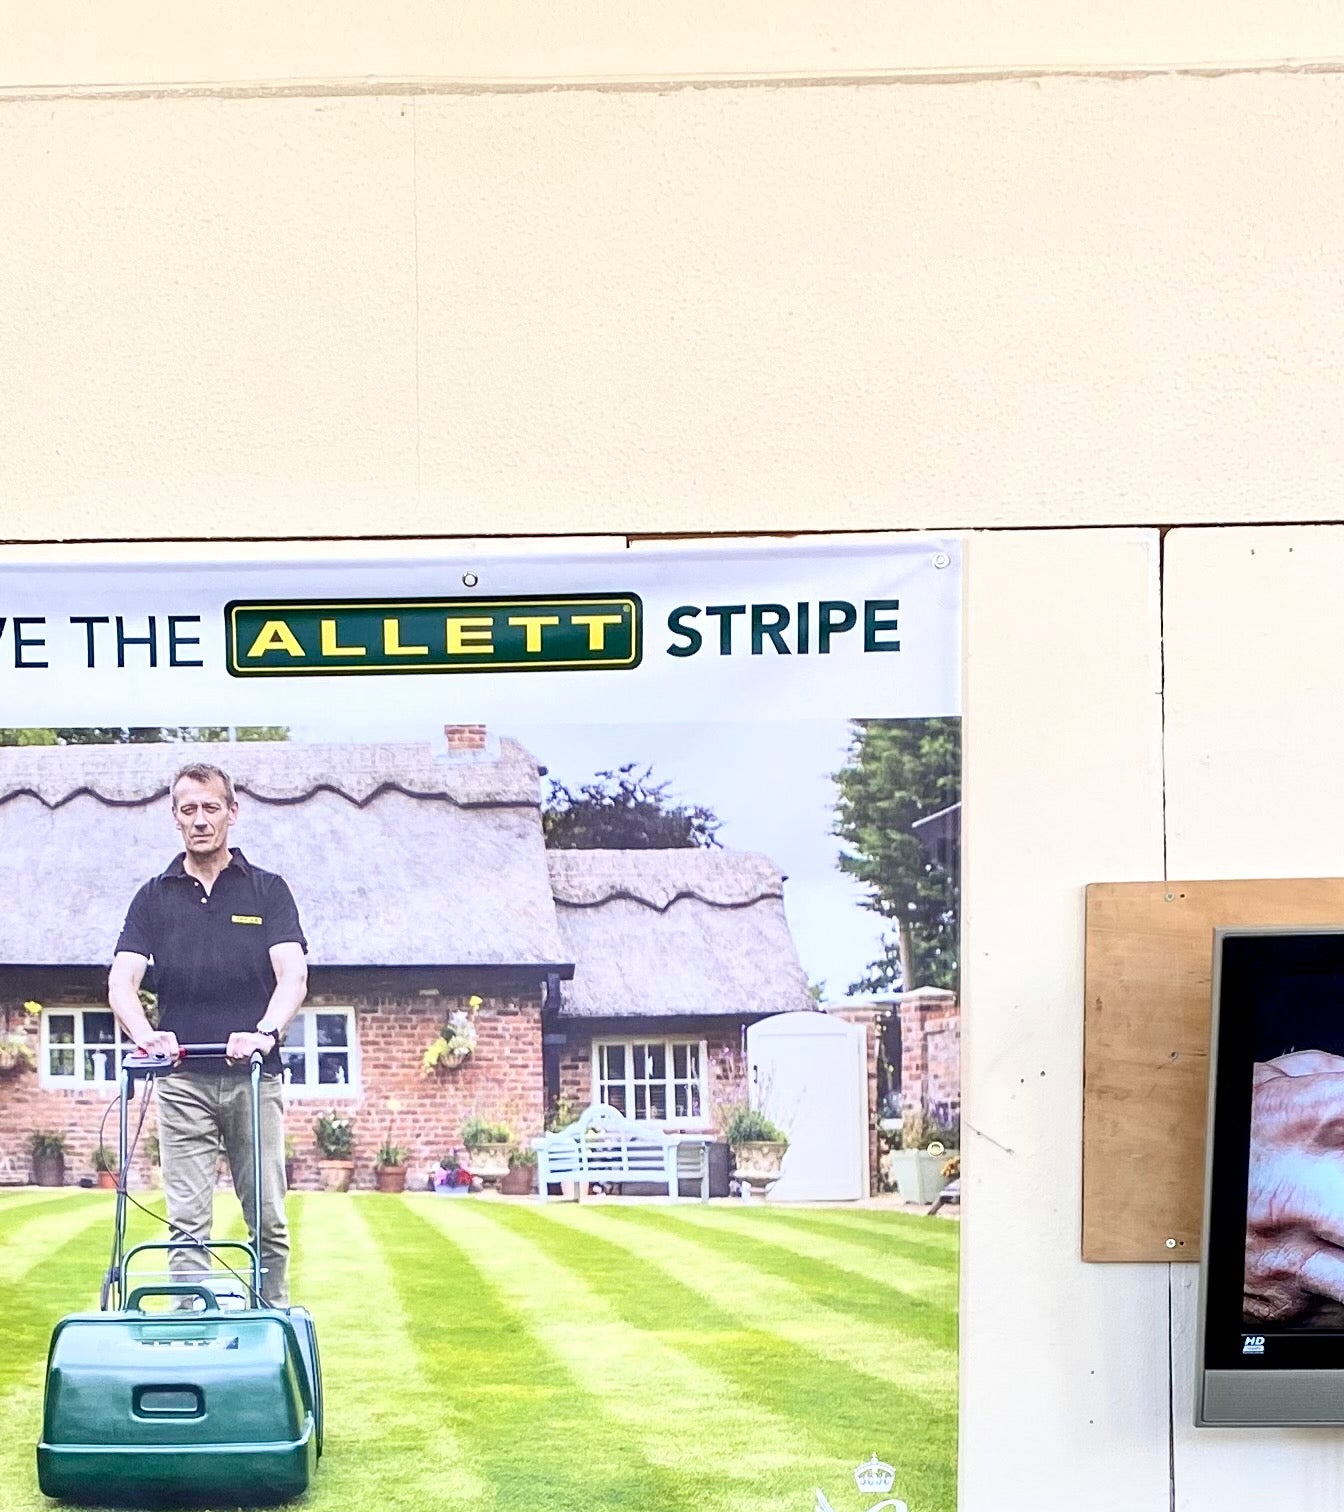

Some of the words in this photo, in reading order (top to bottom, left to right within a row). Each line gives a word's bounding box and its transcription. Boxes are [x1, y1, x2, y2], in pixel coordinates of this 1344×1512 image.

[69, 615, 204, 669] THE
[247, 614, 625, 658] ALLETT
[667, 599, 901, 657] STRIPE
